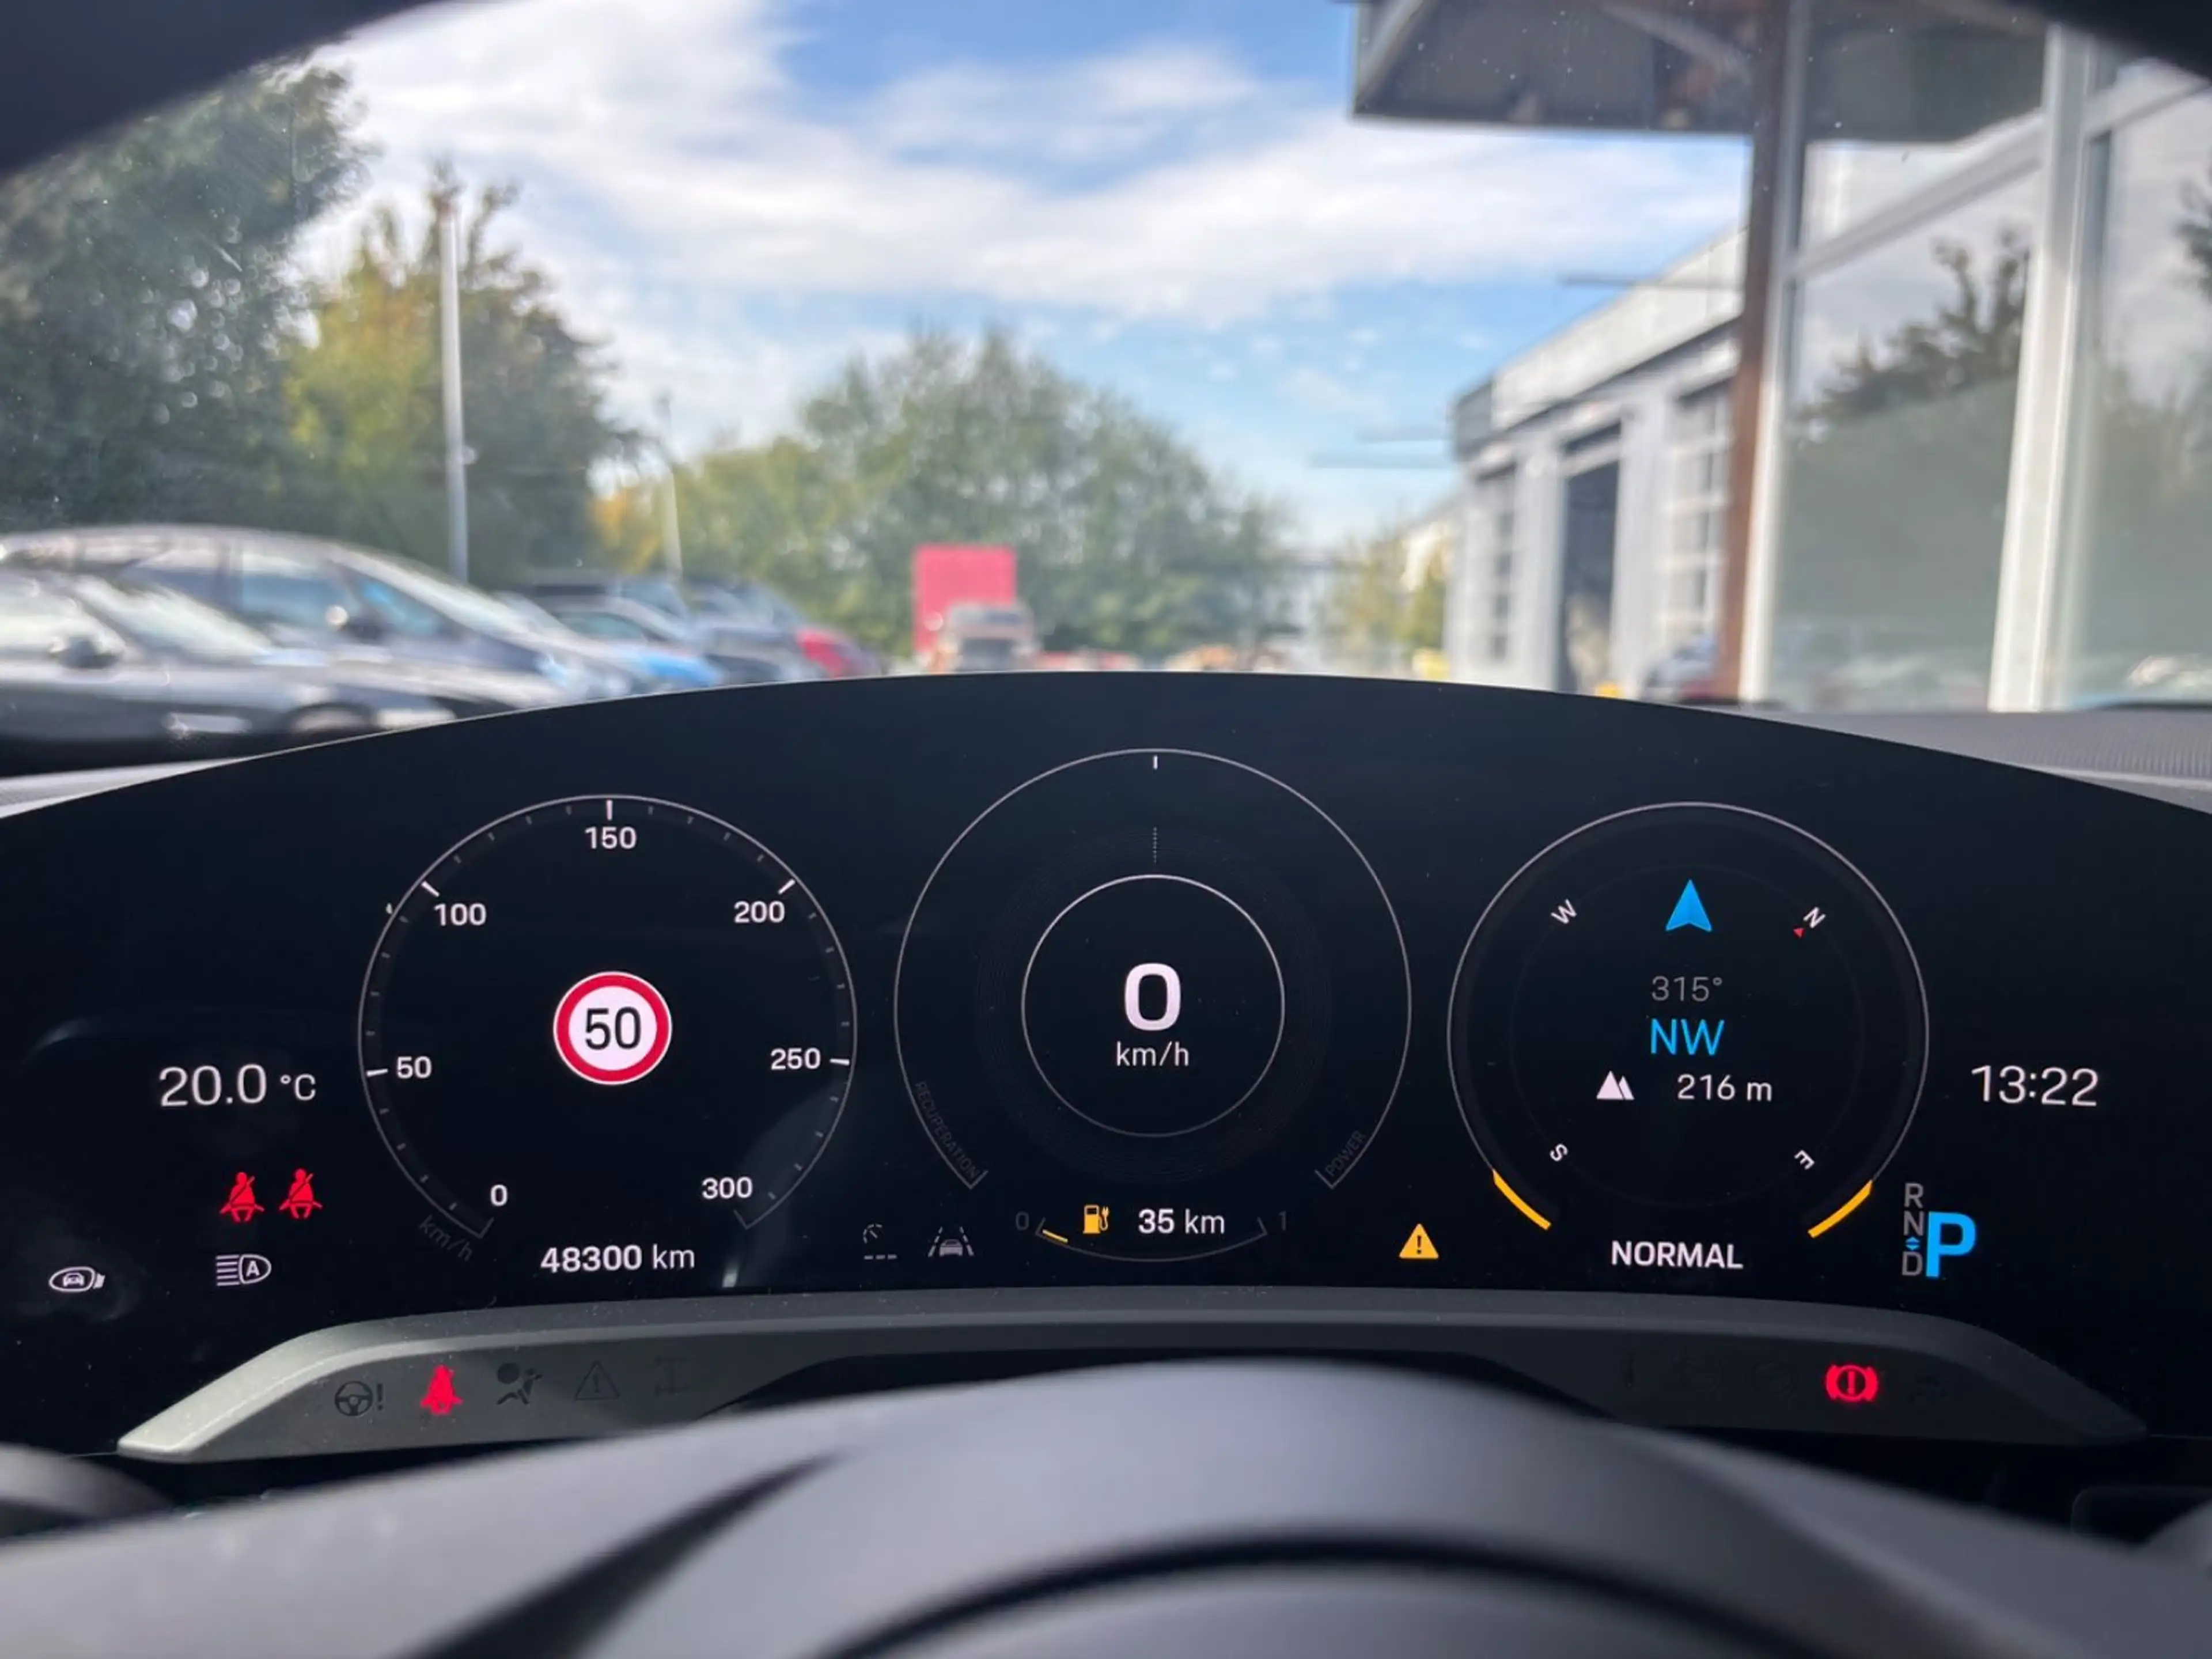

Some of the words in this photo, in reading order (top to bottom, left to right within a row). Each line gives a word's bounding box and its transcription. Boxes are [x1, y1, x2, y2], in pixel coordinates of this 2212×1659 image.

[585, 826, 637, 849] 150
[434, 903, 487, 926] 100
[734, 900, 786, 923] 200
[1551, 899, 1577, 925] W
[1802, 907, 1826, 929] N
[1123, 962, 1181, 1032] 0
[1651, 975, 1723, 1002] 315°
[585, 1006, 642, 1051] 50
[1650, 1018, 1725, 1056] NW
[770, 1047, 821, 1071] 250
[1116, 1041, 1190, 1067] km/h
[396, 1056, 432, 1080] 50
[159, 1063, 267, 1107] 20.0
[279, 1073, 317, 1101] °C
[1676, 1074, 1736, 1101] 216
[1746, 1082, 1773, 1101] m
[1971, 1065, 2099, 1107] 13:22
[1325, 1130, 1366, 1177] POWER
[1550, 1143, 1569, 1162] S
[1794, 1149, 1816, 1170] E
[490, 1184, 508, 1206] 0
[702, 1176, 753, 1200] 300
[1904, 1182, 1925, 1209] R
[1015, 1211, 1030, 1231] 0
[1138, 1209, 1175, 1234] 35
[1184, 1209, 1225, 1234] km
[1277, 1211, 1287, 1232] 1
[1903, 1210, 1925, 1236] N
[418, 1213, 474, 1262] km/h
[1926, 1211, 1977, 1279] P
[540, 1244, 643, 1274] 48300
[652, 1244, 696, 1270] km
[1611, 1240, 1744, 1270] NORMAL
[1902, 1251, 1924, 1277] D
